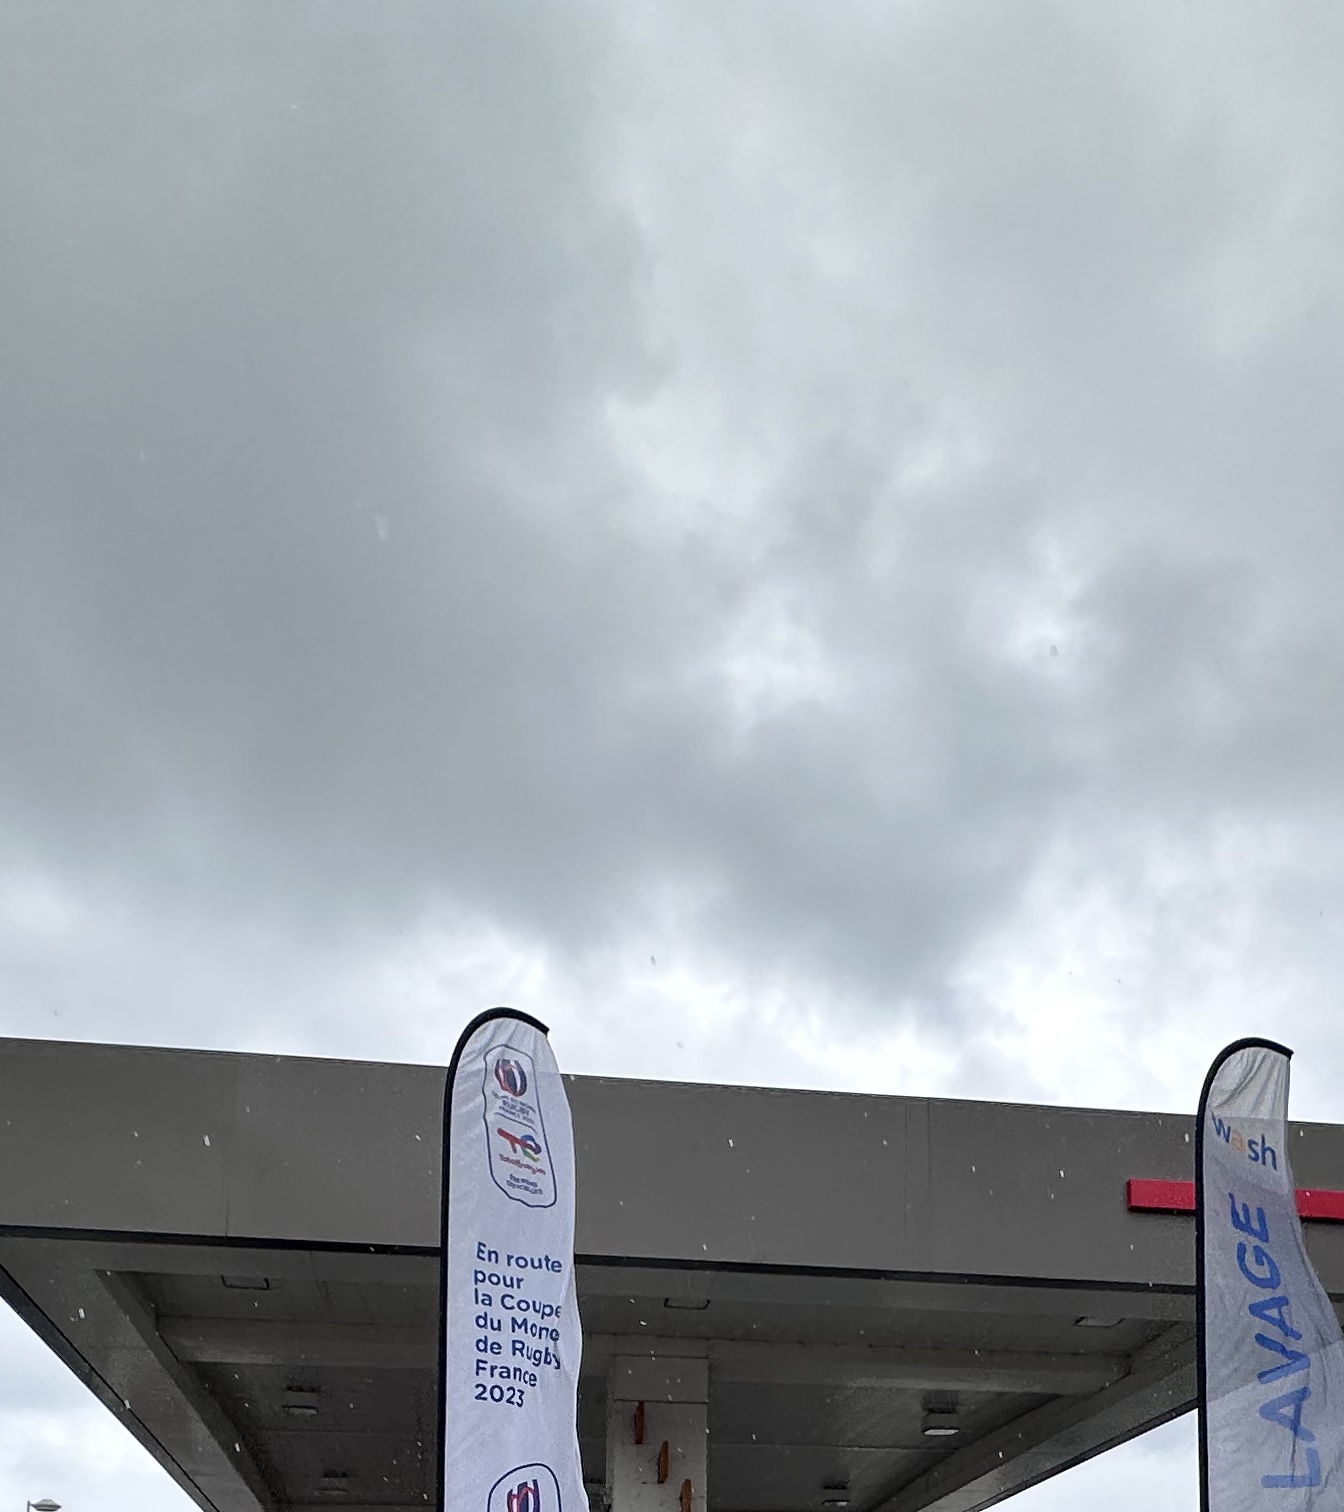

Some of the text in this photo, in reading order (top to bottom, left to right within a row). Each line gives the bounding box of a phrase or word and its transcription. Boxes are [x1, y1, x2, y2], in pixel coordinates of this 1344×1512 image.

[1211, 1110, 1278, 1171] wash
[476, 1241, 563, 1273] En route
[474, 1269, 524, 1289] pour
[474, 1288, 562, 1320] la Coupe
[475, 1311, 502, 1332] du
[476, 1336, 561, 1370] de Rugby
[1228, 1192, 1322, 1488] LAVAGE
[476, 1359, 537, 1387] France
[474, 1384, 525, 1408] 2023
